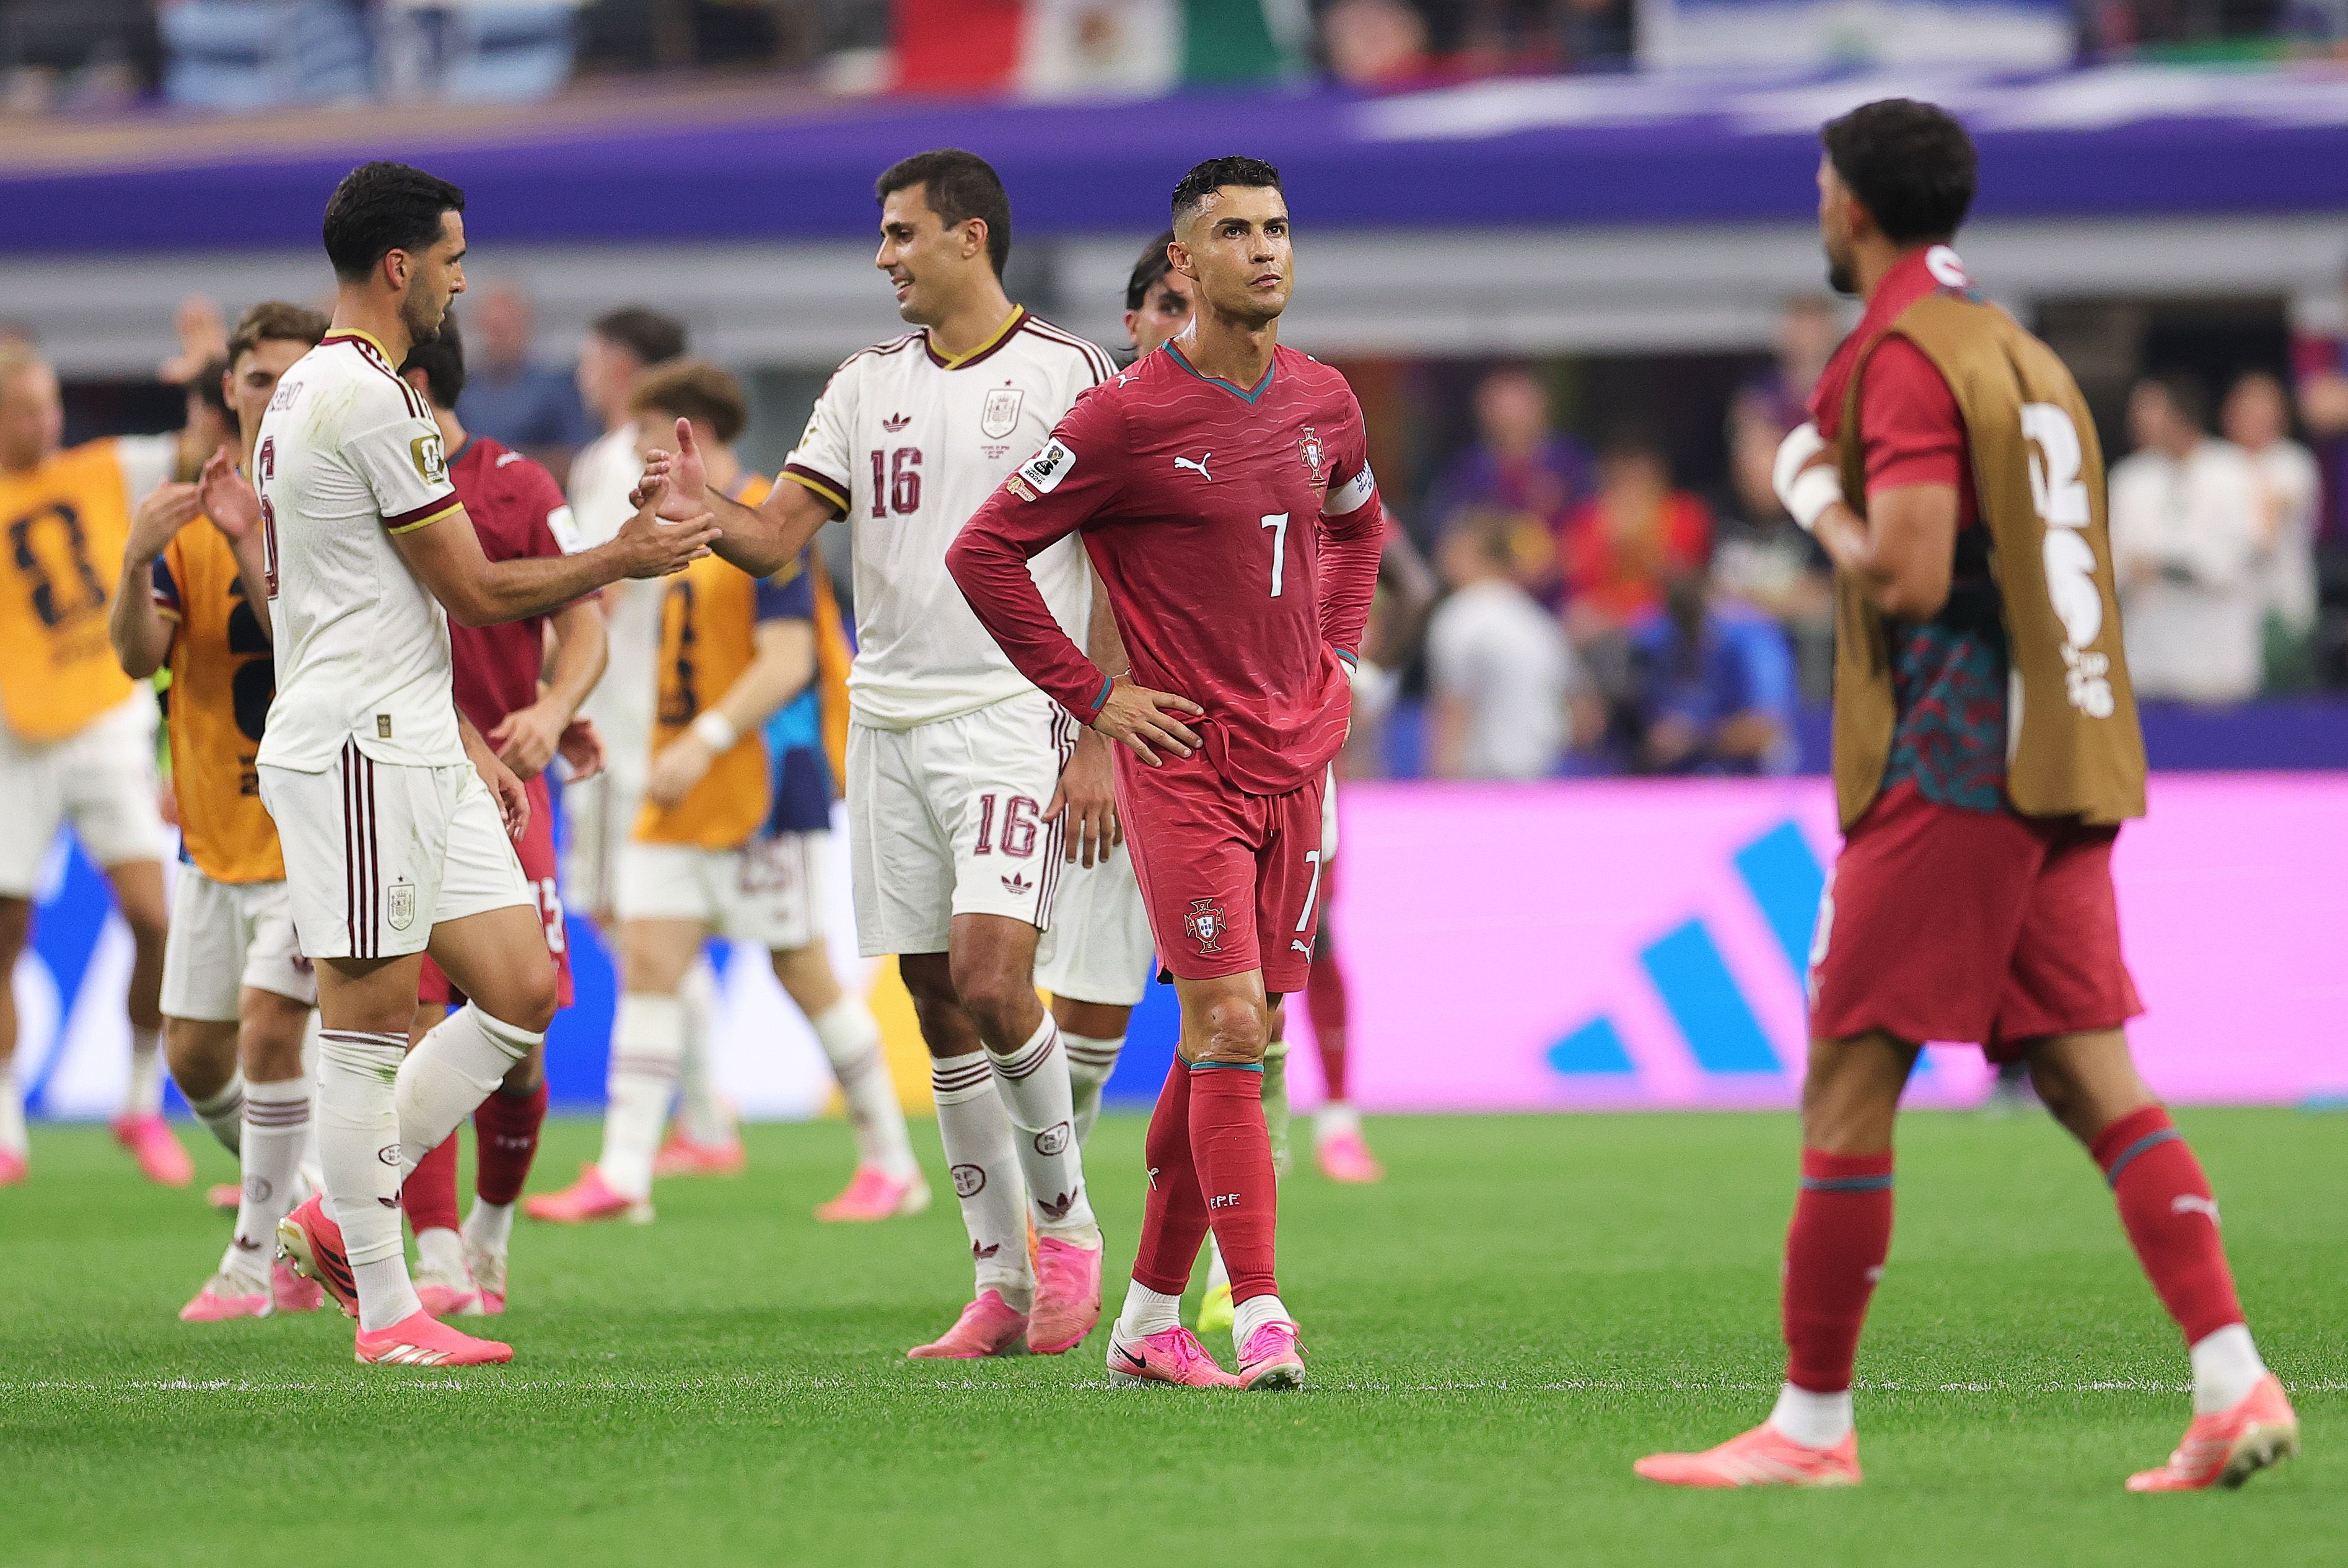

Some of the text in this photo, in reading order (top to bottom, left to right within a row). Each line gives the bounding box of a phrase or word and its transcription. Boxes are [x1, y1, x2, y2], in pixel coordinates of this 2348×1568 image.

[870, 447, 922, 519] 16
[1025, 469, 1043, 485] 2026
[1261, 512, 1289, 597] 7
[973, 794, 1040, 858] 16
[1295, 849, 1320, 932] 7
